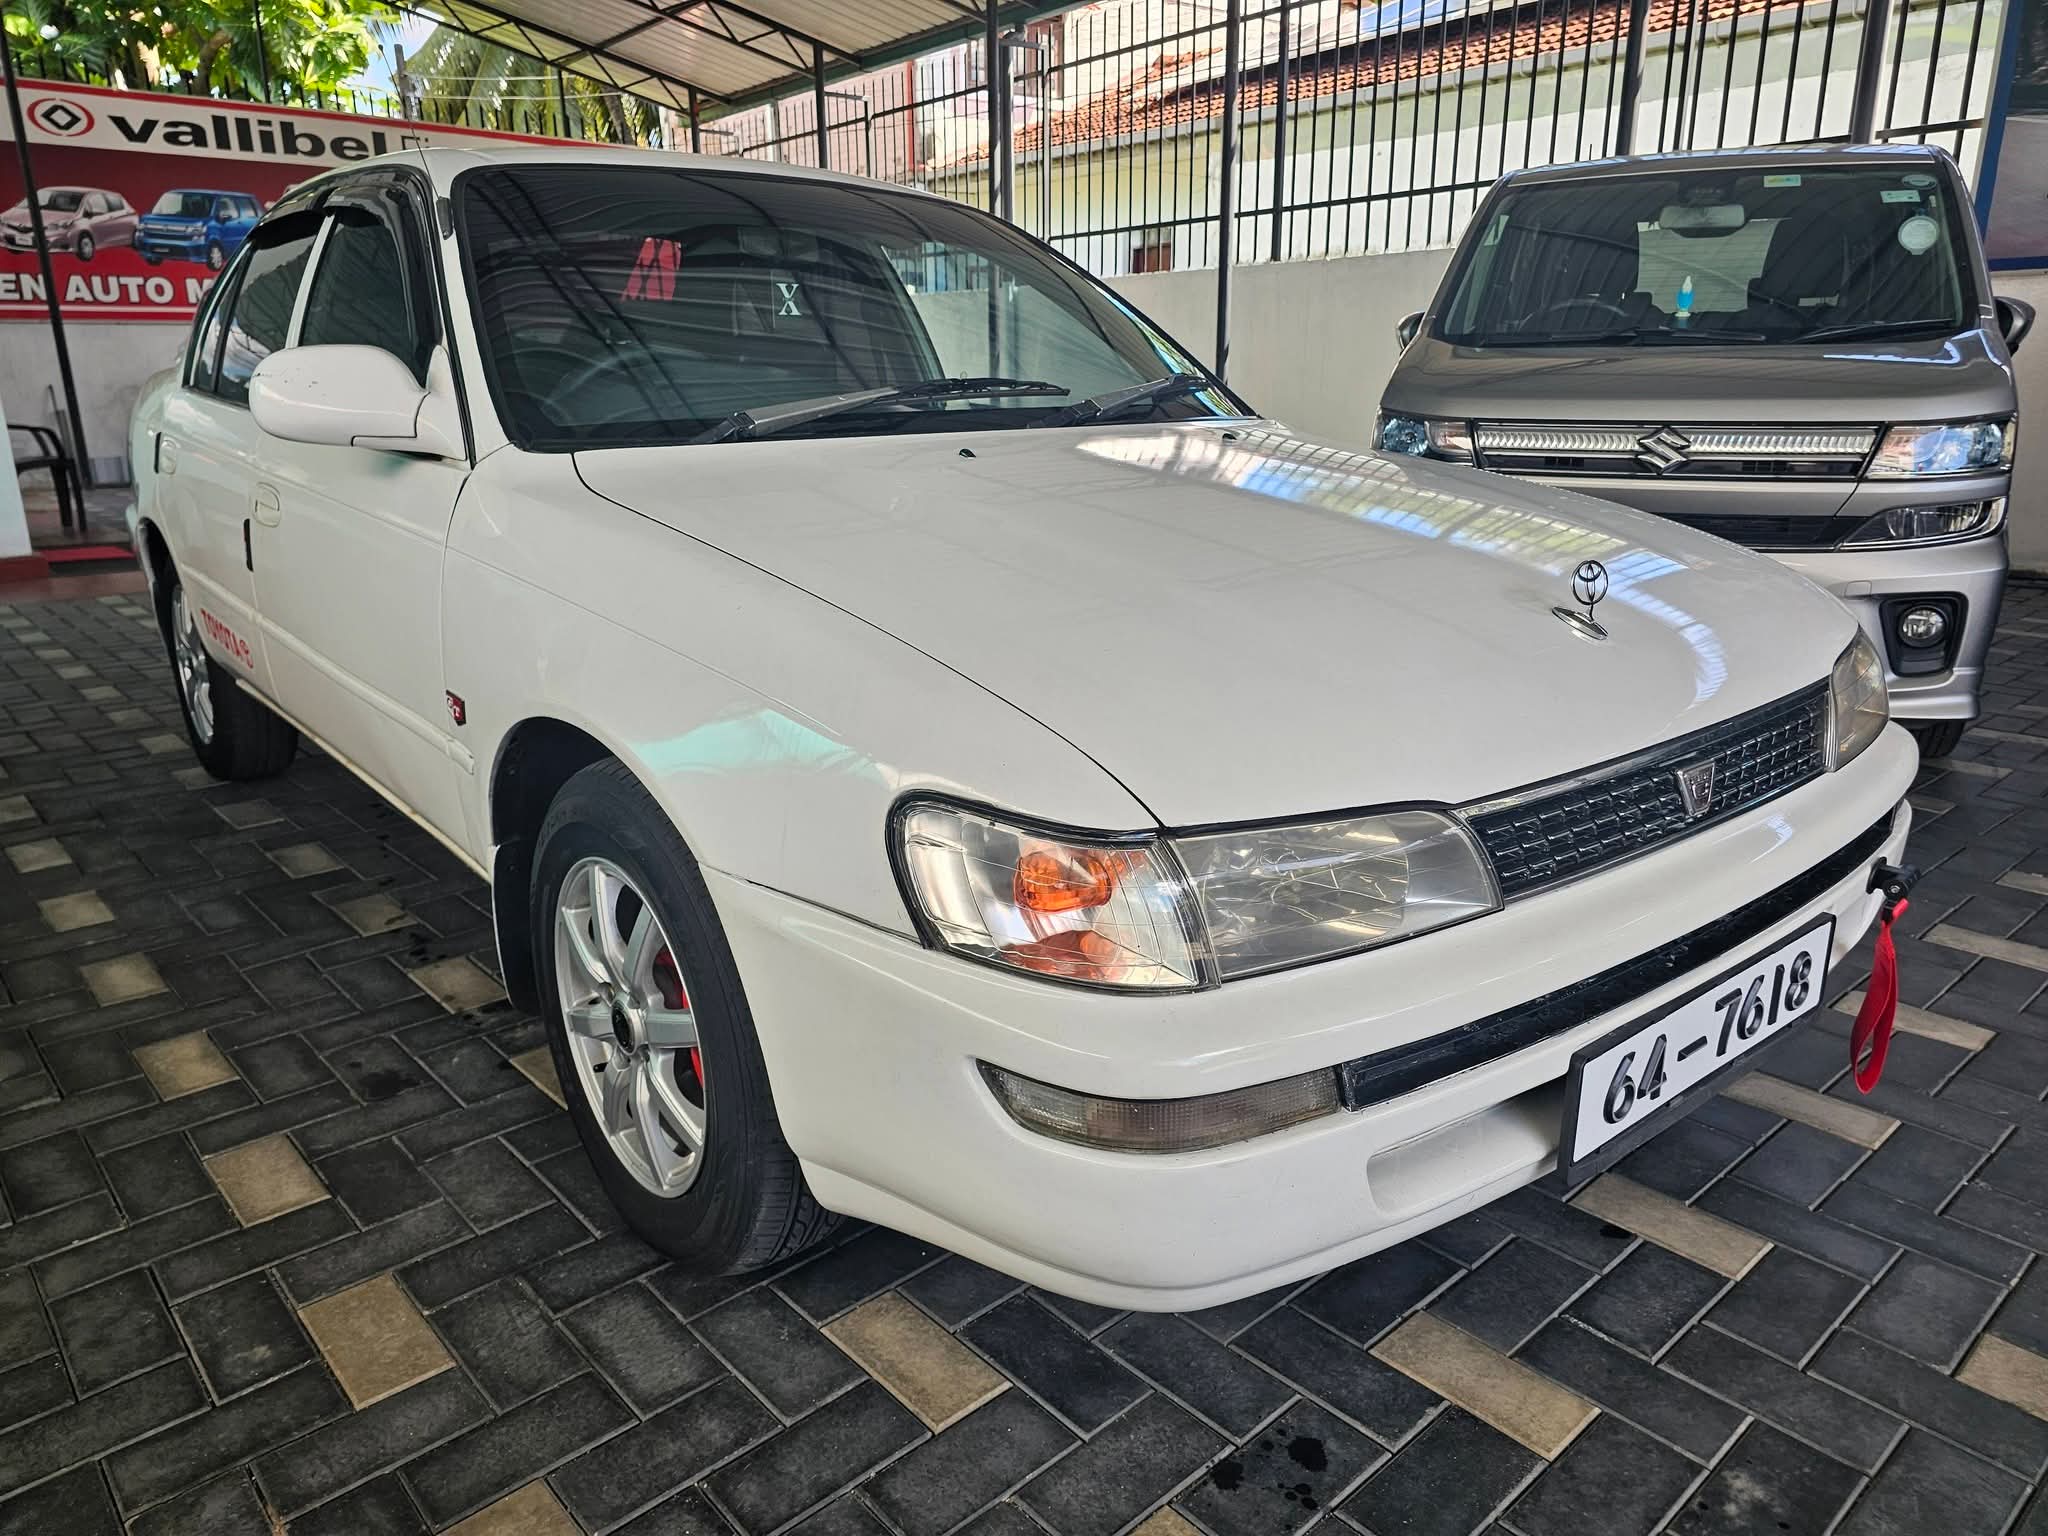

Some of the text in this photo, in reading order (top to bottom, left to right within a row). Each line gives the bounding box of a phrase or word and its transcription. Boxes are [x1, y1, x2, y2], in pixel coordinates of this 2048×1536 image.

[109, 114, 386, 160] vallibel
[65, 275, 174, 304] AUTO
[1602, 951, 1812, 1124] 64-7618
